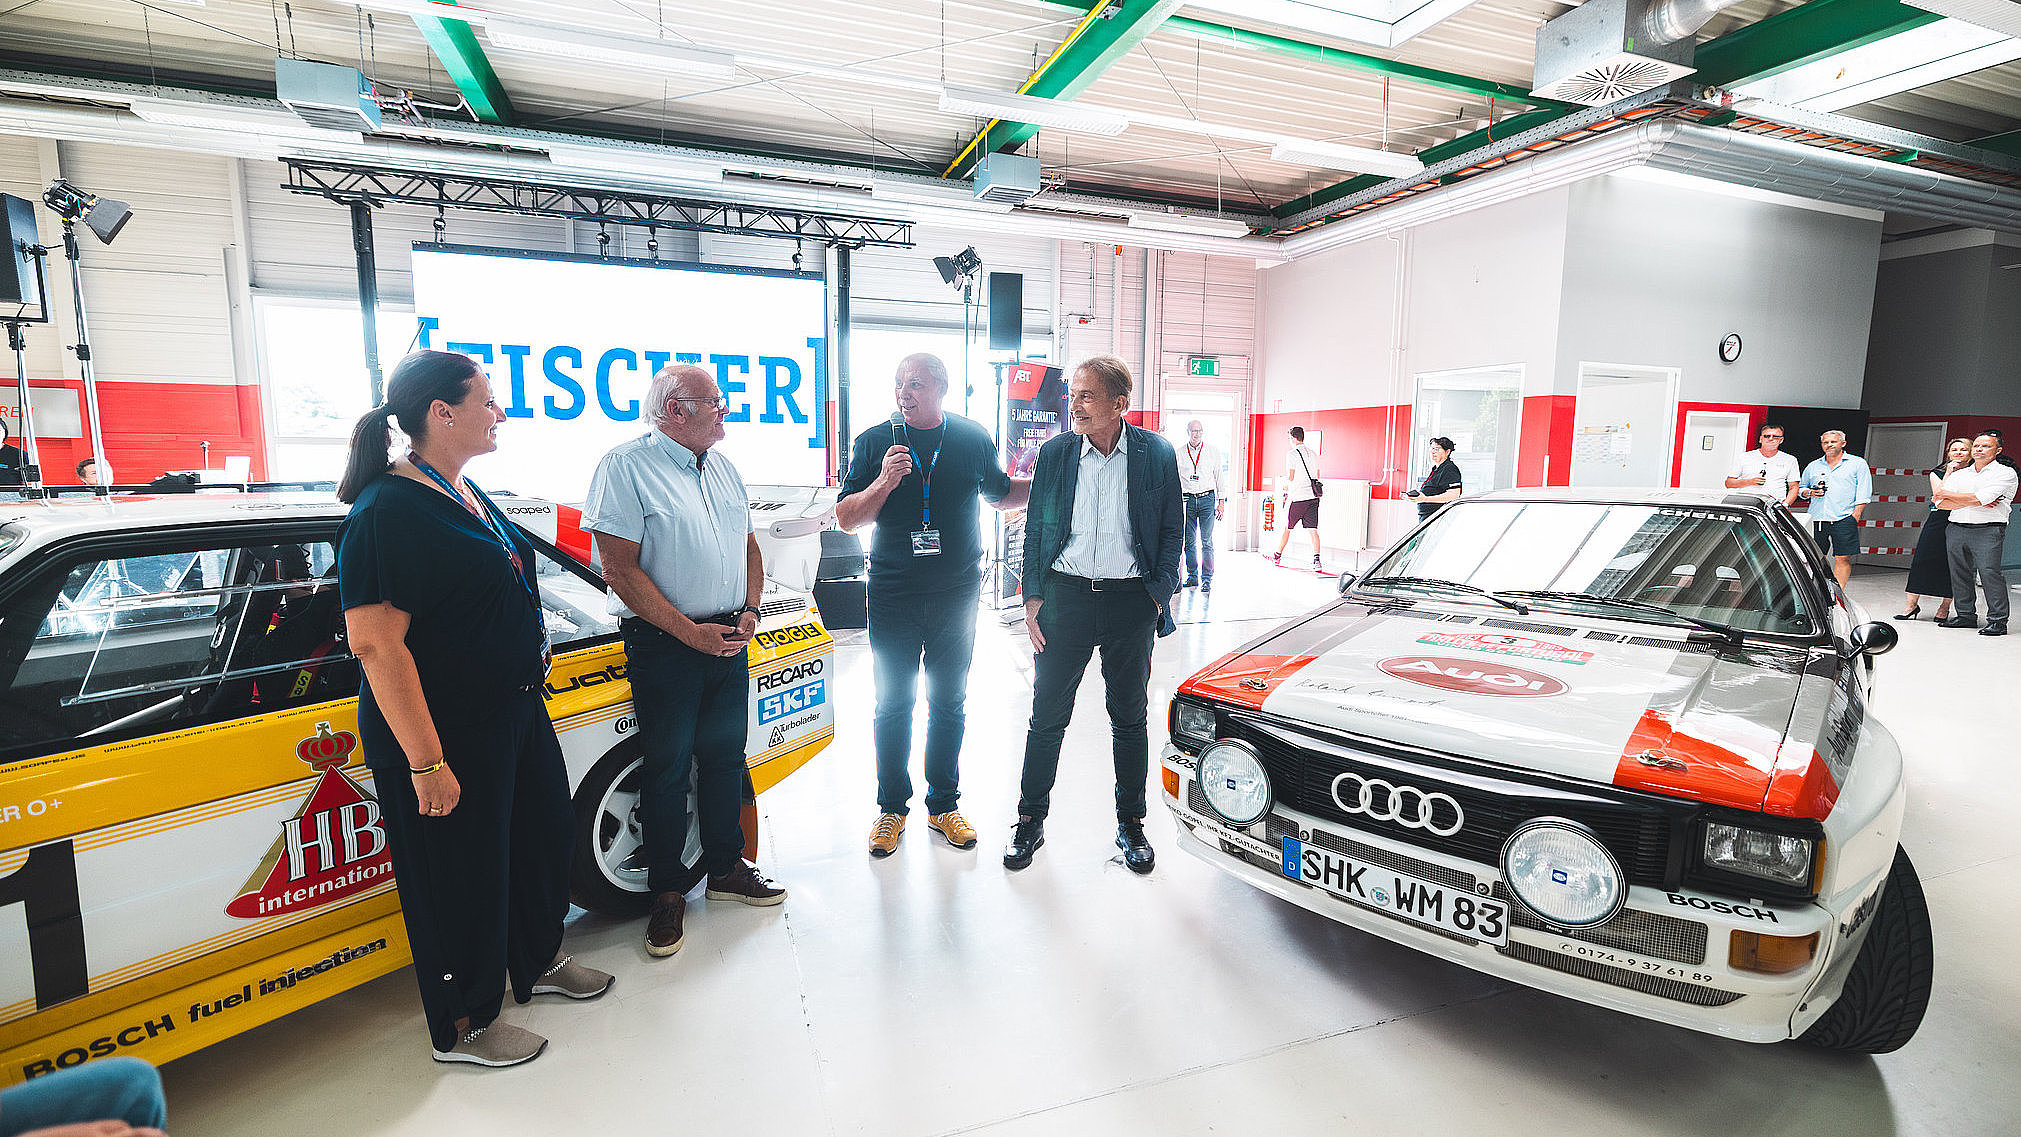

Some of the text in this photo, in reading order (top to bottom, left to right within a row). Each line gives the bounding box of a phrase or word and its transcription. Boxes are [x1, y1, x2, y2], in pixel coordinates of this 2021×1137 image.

[1013, 369, 1031, 384] ABT
[506, 505, 551, 516] soaped
[757, 624, 820, 648] BOGE
[1500, 637, 1517, 645] 3
[757, 659, 824, 693] RECARO
[762, 682, 823, 721] SKF
[780, 712, 821, 733] Turbolader
[1167, 754, 1197, 772] BOS
[282, 800, 387, 883] HB
[1287, 861, 1296, 871] D
[258, 861, 393, 914] internation
[1302, 850, 1504, 938] SHK WM 83
[1666, 892, 1779, 923] BOSCH
[1641, 961, 1662, 972] 37
[1666, 966, 1684, 978] 61
[1692, 972, 1713, 983] 89
[22, 938, 387, 1081] BOSCH fuel injection
